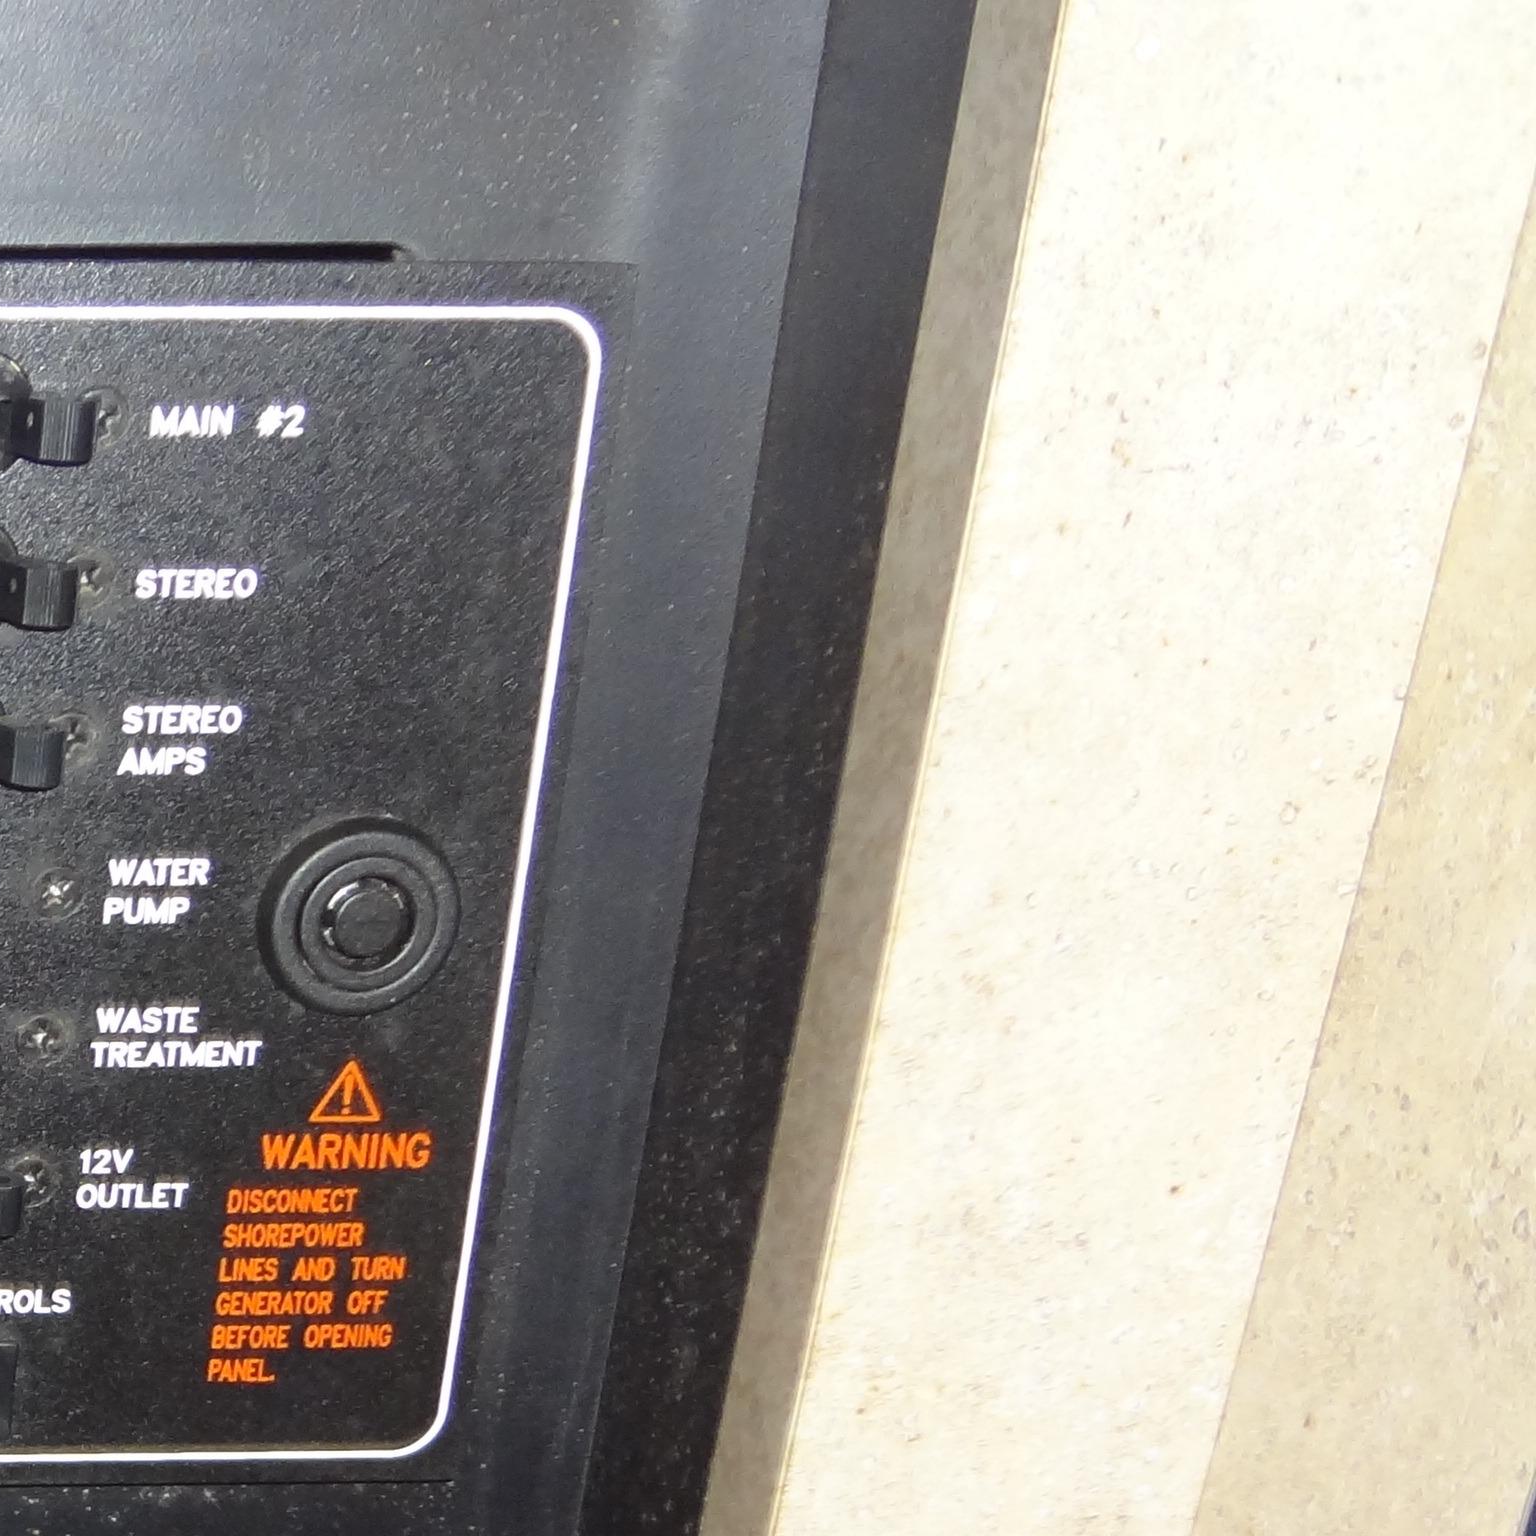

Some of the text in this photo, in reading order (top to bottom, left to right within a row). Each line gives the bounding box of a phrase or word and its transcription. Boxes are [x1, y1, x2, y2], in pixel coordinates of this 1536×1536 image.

[148, 404, 306, 440] MAIN #2
[134, 567, 258, 600] STEREO
[121, 703, 243, 735] STEREO
[116, 746, 207, 776] AMPS
[108, 857, 211, 887] WATER
[102, 896, 191, 925] PUMP
[95, 1006, 200, 1034] WASTE
[89, 1040, 263, 1068] TREATMENT
[79, 1148, 134, 1175] 12V
[261, 1131, 431, 1169] WARNING
[75, 1182, 190, 1210] OUTLET
[227, 1187, 358, 1214] DISCONNECT
[224, 1221, 365, 1249] SHOREPOWER
[218, 1254, 407, 1285] LINES AND TURN
[215, 1288, 388, 1317] GENERATOR OFF
[210, 1322, 393, 1350] BEFORE OPENING
[207, 1356, 277, 1383] PANEL.
